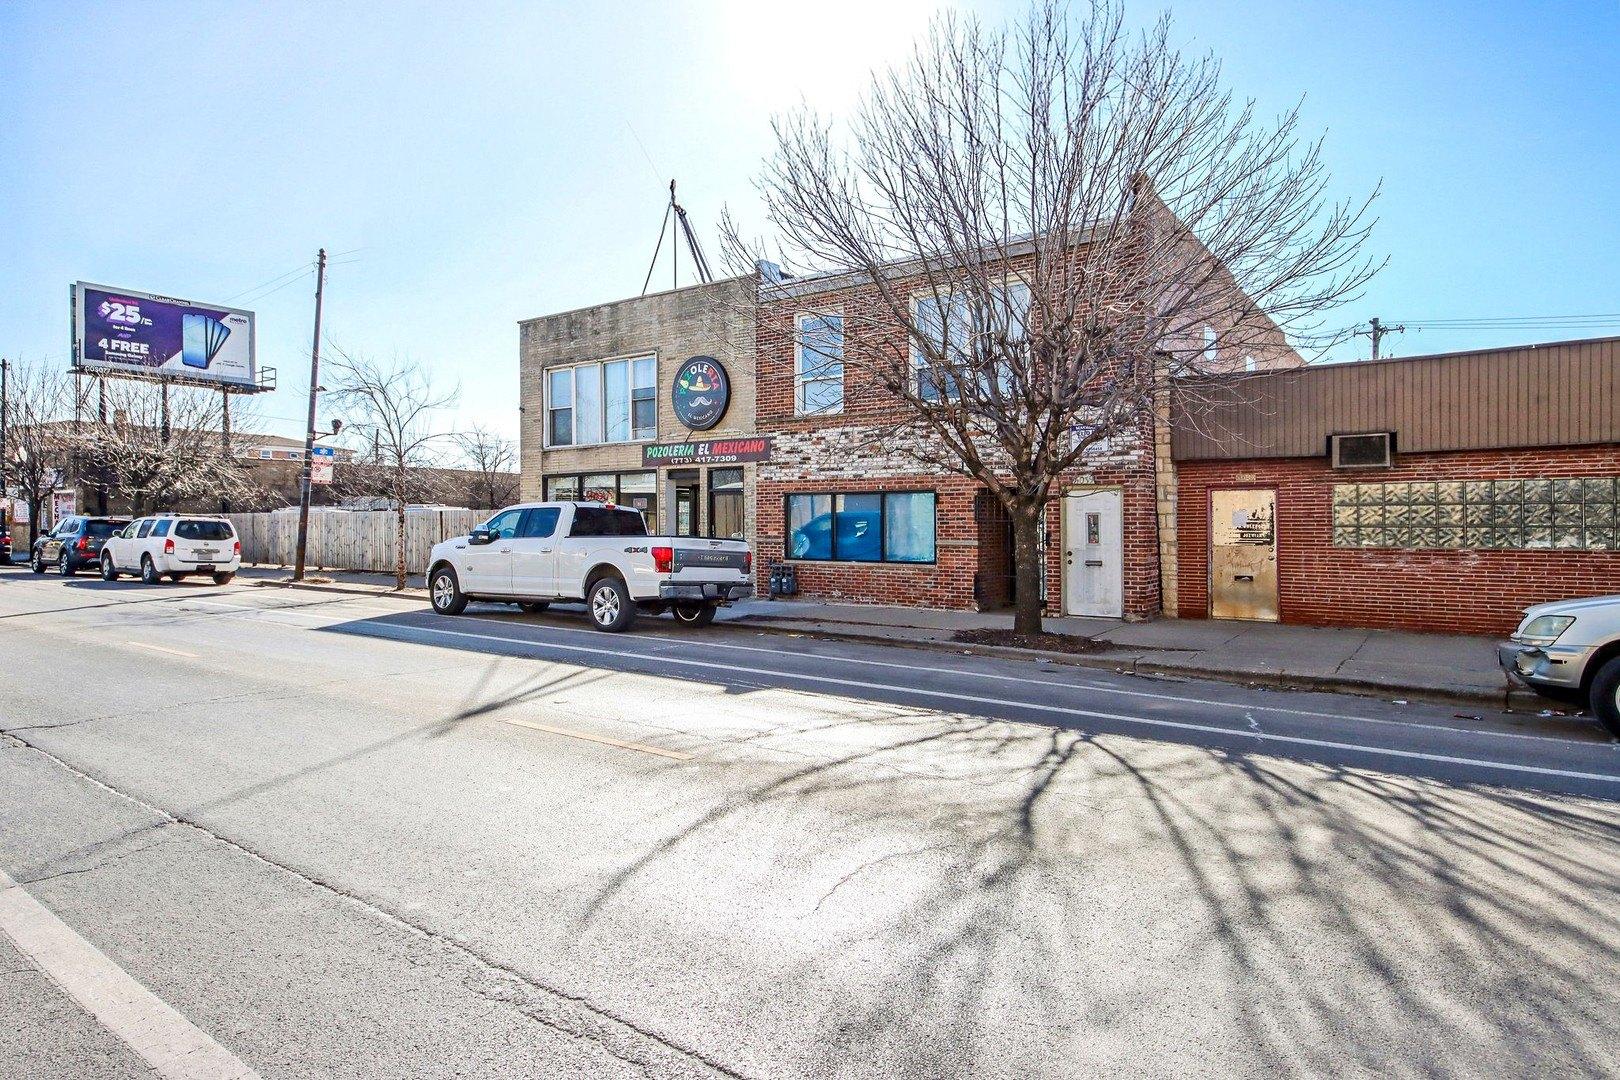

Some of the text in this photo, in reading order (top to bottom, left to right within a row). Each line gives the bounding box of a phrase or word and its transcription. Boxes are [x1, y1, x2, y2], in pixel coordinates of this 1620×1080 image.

[98, 338, 150, 354] 4 FREE
[646, 439, 765, 459] POZOLERIA EL MEXICANO
[695, 454, 737, 463] 417-7309
